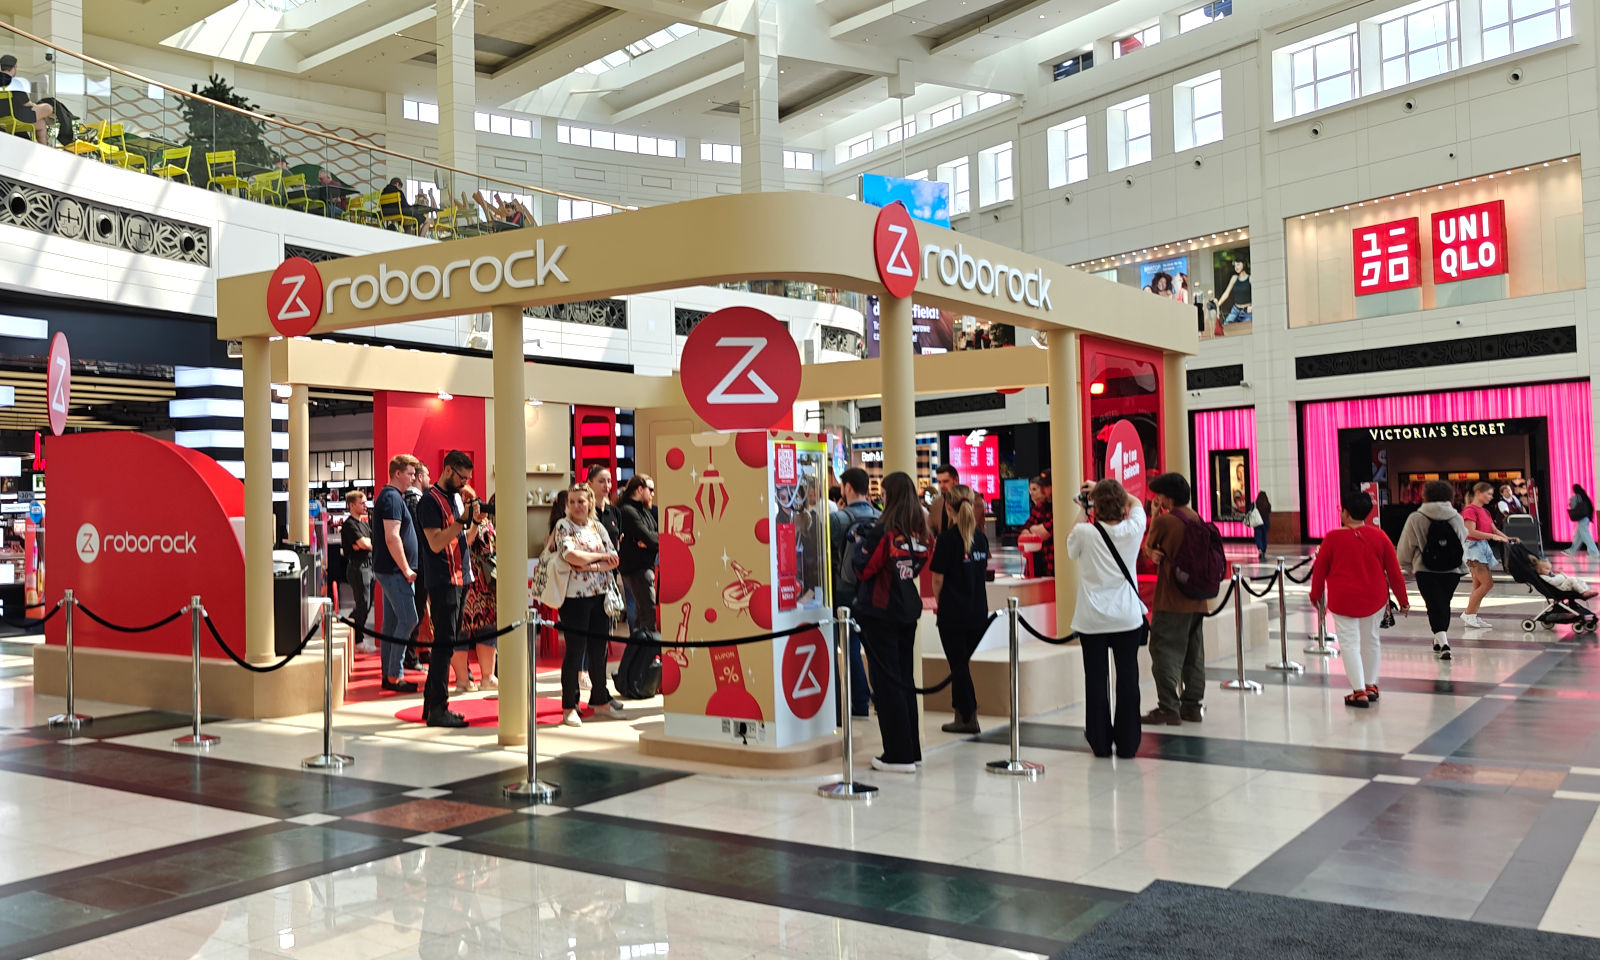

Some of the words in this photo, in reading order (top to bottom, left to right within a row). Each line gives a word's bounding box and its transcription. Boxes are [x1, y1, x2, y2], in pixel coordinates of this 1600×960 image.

[1439, 211, 1489, 244] UNI
[1441, 241, 1496, 277] QLO
[326, 238, 569, 314] roborock
[921, 243, 1052, 311] roborock
[912, 304, 940, 319] field!
[965, 429, 988, 447] 4F
[1369, 425, 1447, 440] VICTORIA'S
[1452, 422, 1505, 437] SECRET
[970, 447, 978, 467] SALE
[986, 447, 994, 467] SALE
[986, 474, 995, 494] SALE
[103, 531, 197, 554] roborock
[714, 651, 735, 661] KUPON
